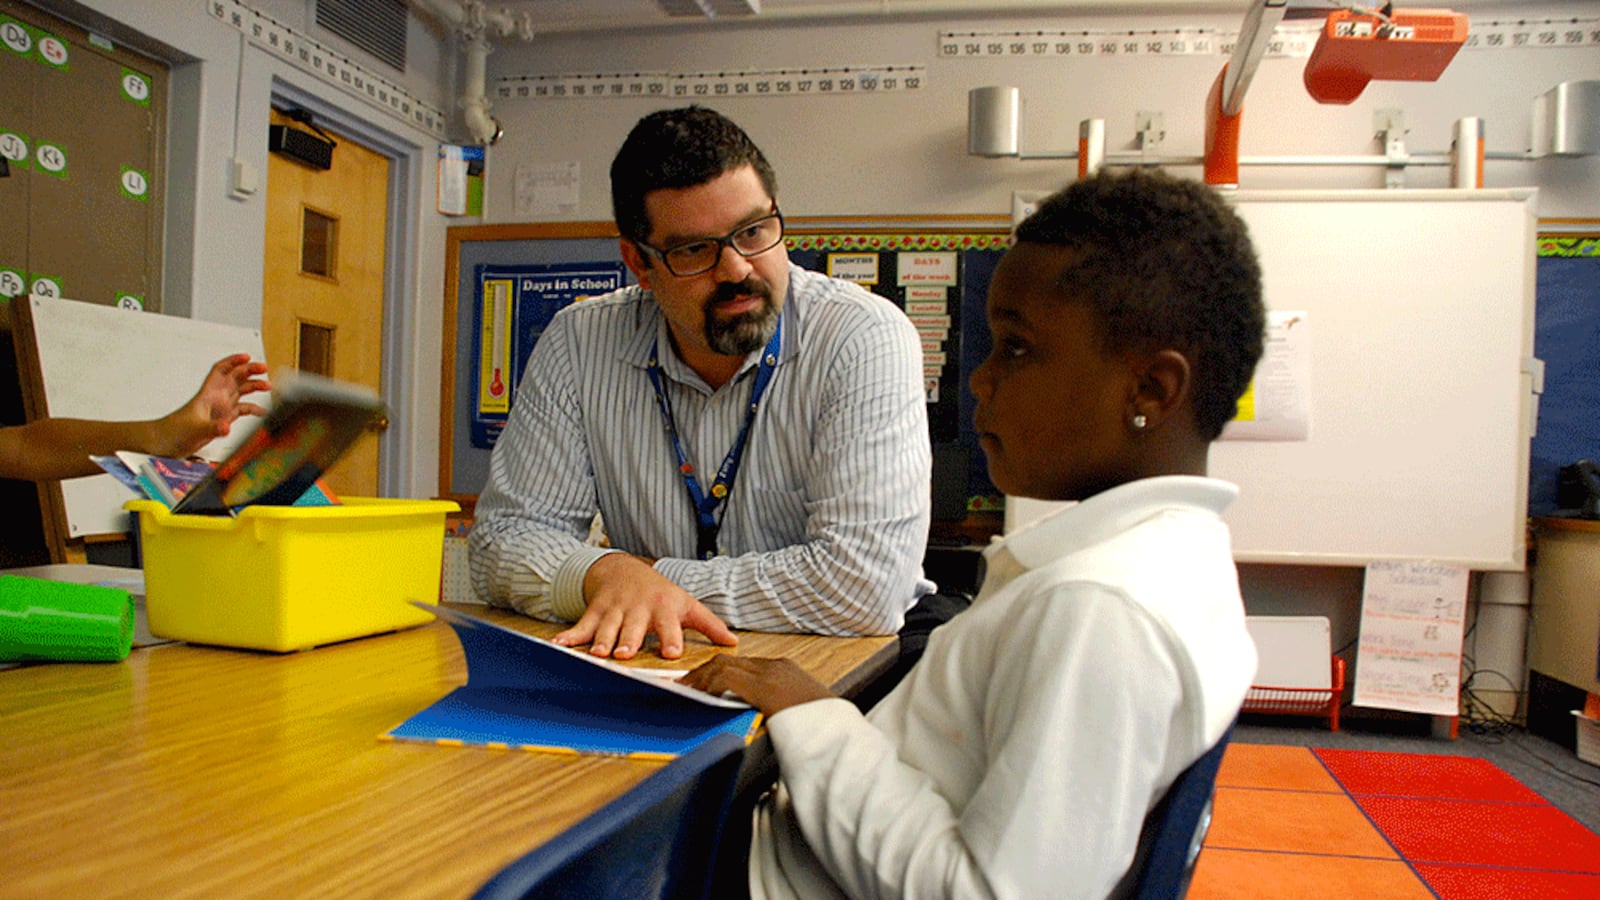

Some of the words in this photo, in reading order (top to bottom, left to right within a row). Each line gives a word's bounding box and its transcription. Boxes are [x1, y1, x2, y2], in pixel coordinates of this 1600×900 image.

[798, 80, 812, 91] 127
[883, 77, 897, 89] 131
[905, 77, 920, 88] 132
[523, 280, 552, 293] Days
[571, 278, 615, 290] School
